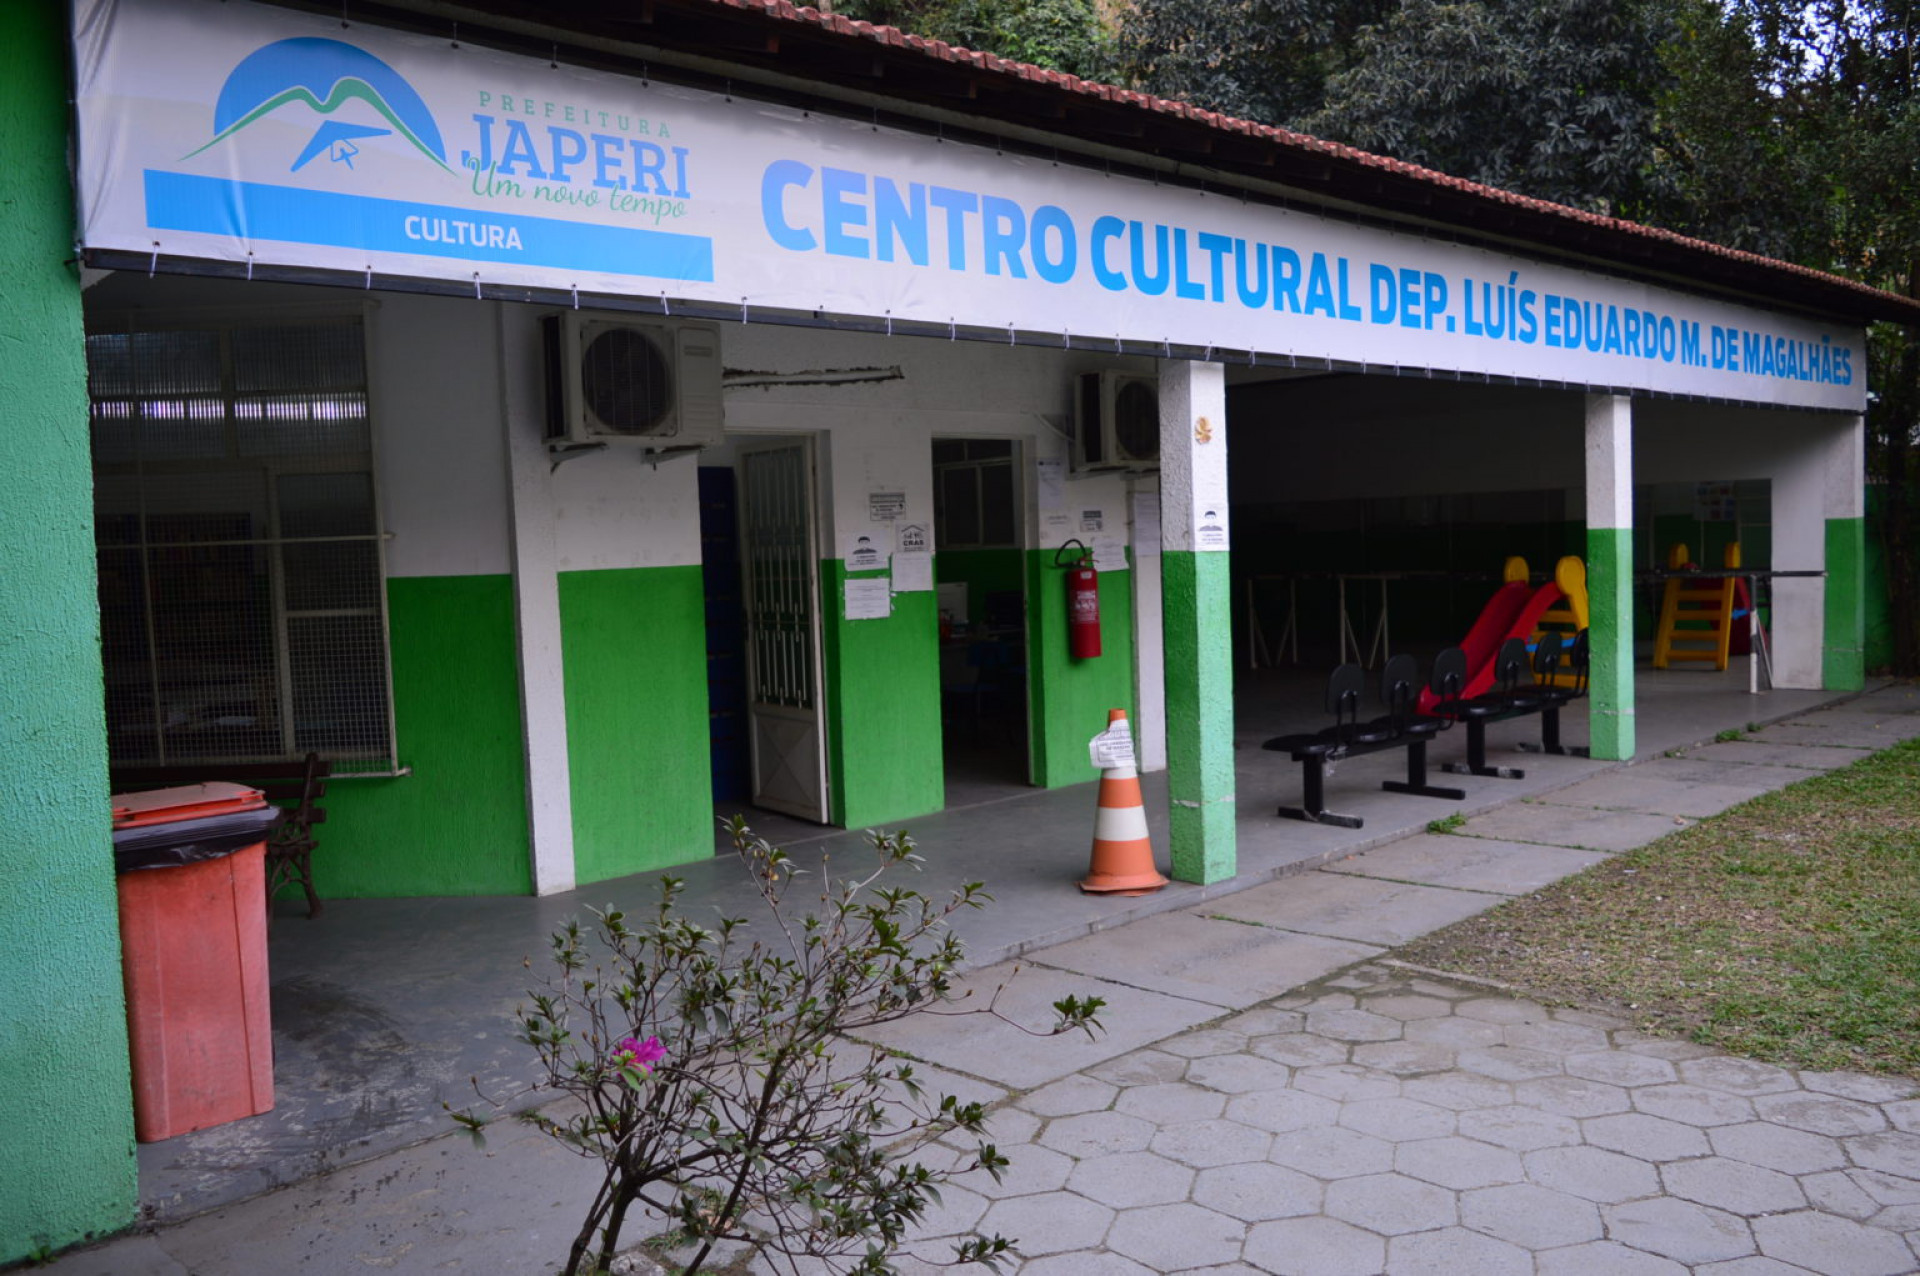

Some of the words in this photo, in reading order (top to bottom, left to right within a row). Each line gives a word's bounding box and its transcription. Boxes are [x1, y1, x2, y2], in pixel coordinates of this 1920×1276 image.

[479, 90, 671, 138] PREFEITURA
[462, 113, 691, 199] JAPERI
[466, 157, 526, 200] Um
[534, 182, 600, 209] novo
[609, 182, 688, 226] tempo
[403, 214, 524, 252] CULTURA
[761, 158, 1078, 285] CENTRO
[1090, 214, 1362, 323] CULTURAL
[1369, 262, 1456, 333] DEP.
[1464, 270, 1538, 344] LUÍS
[1544, 294, 1677, 363] EDUARDO
[1681, 320, 1707, 368] M.
[1711, 324, 1739, 371] DE
[1743, 331, 1853, 386] MAGALHÃES
